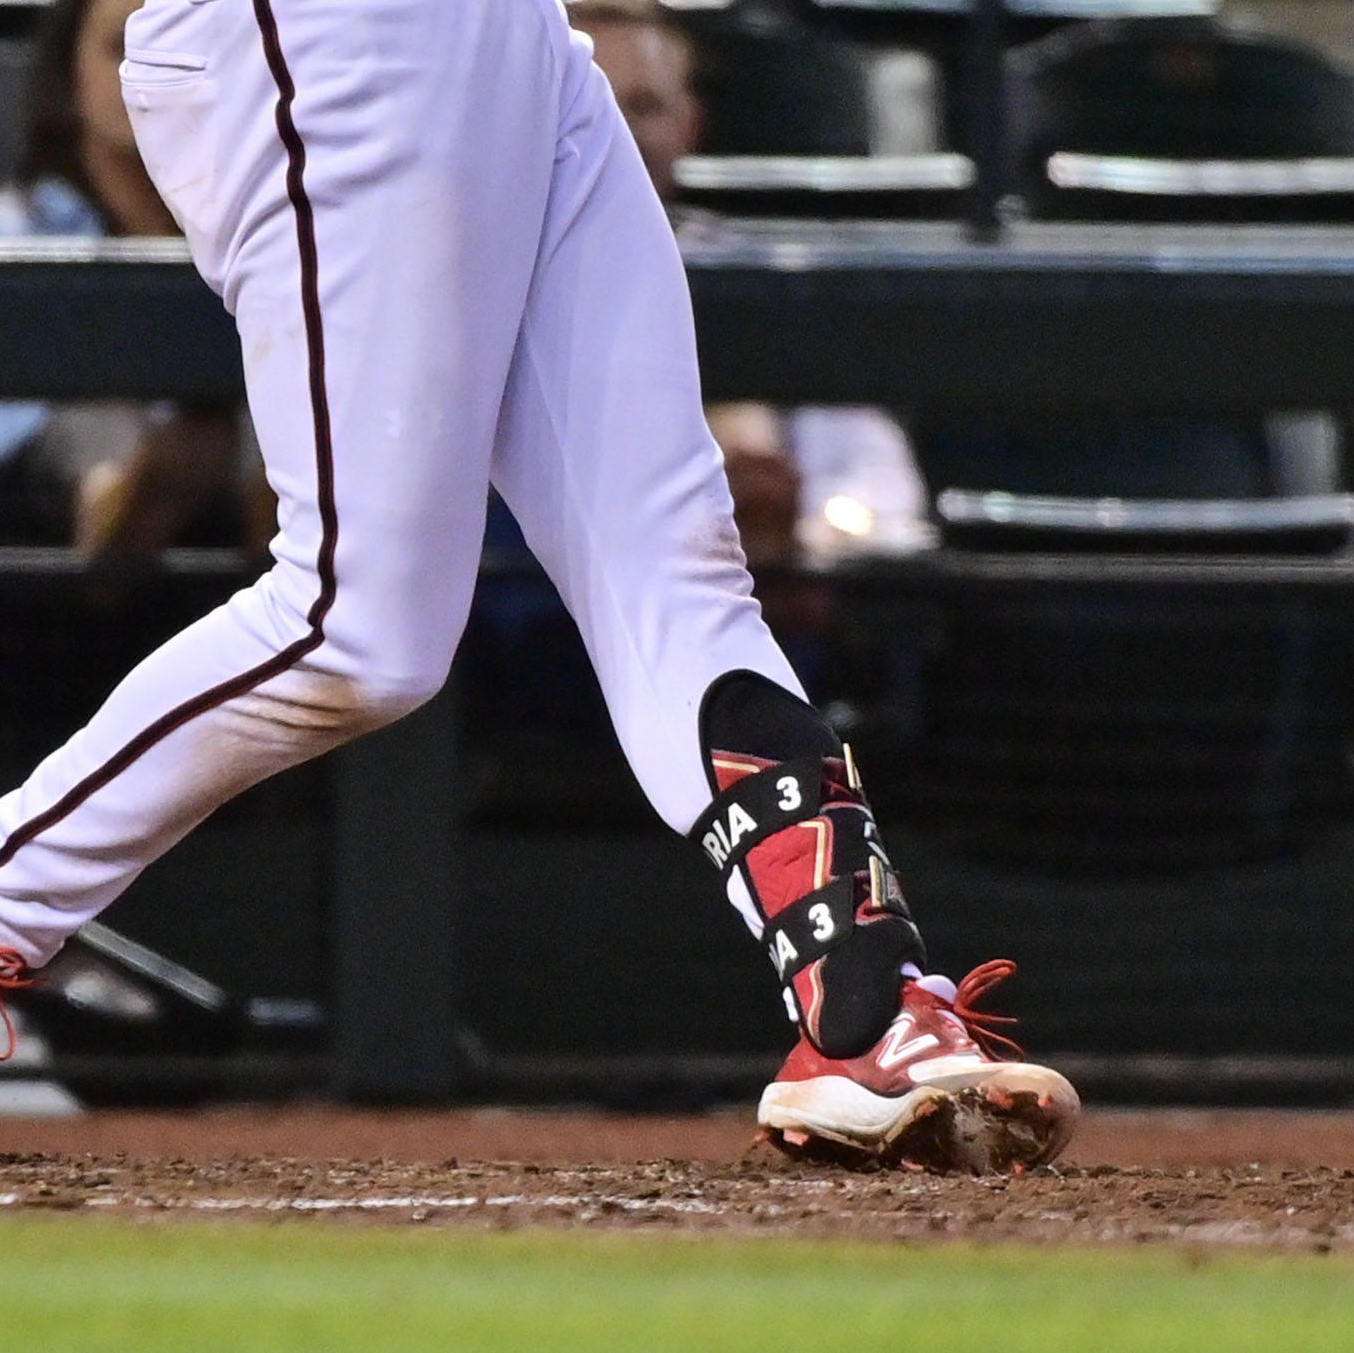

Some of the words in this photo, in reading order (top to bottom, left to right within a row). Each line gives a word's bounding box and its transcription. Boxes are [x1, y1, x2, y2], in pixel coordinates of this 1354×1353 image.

[701, 802, 758, 872] RIA
[776, 776, 802, 811] 3
[808, 903, 834, 942] 3
